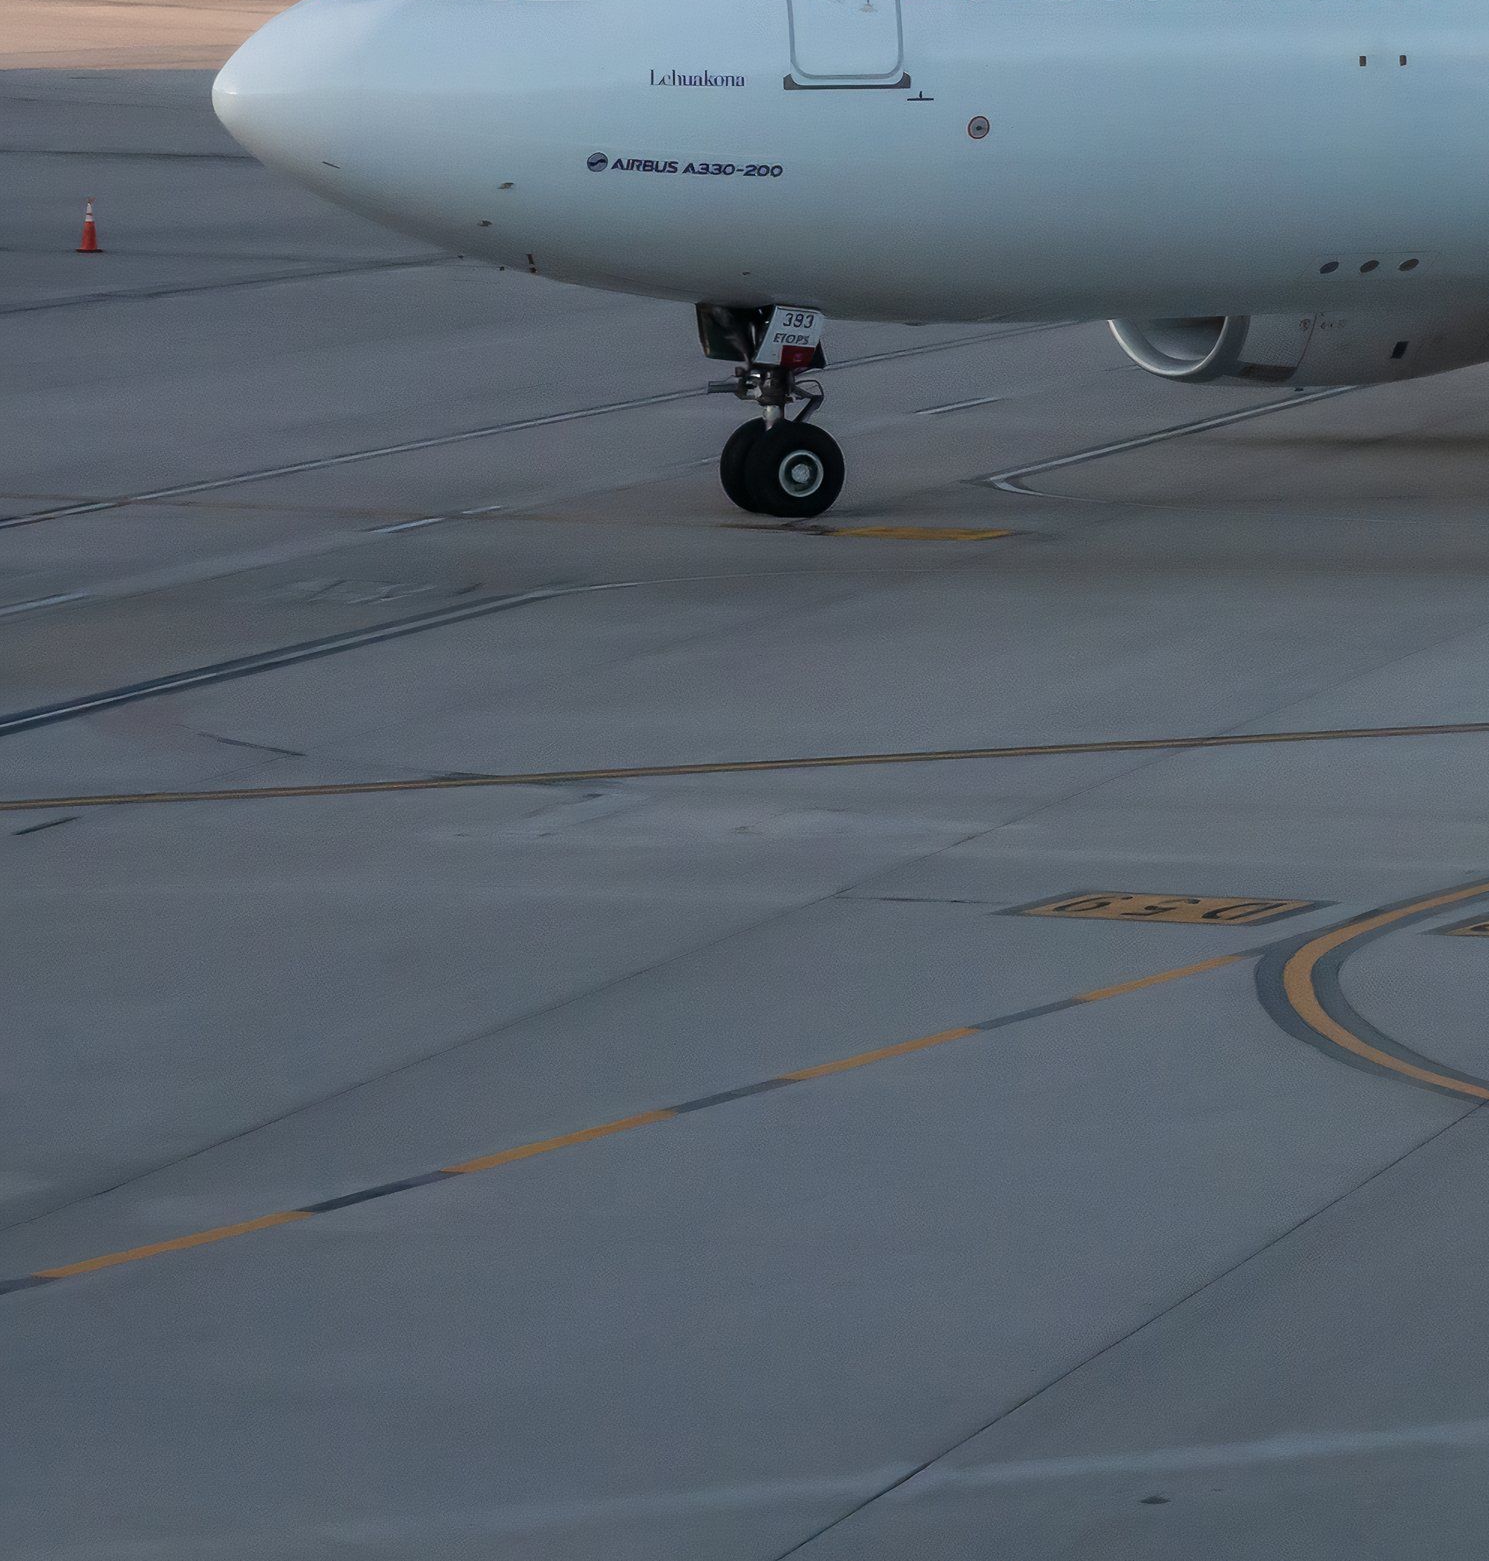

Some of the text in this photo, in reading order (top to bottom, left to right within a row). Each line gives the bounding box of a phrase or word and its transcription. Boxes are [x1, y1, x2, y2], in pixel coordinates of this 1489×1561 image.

[611, 158, 783, 177] AIRBUS A330-200
[782, 312, 815, 329] 393
[773, 332, 810, 345] ETOPS
[1052, 896, 1288, 920] D59
